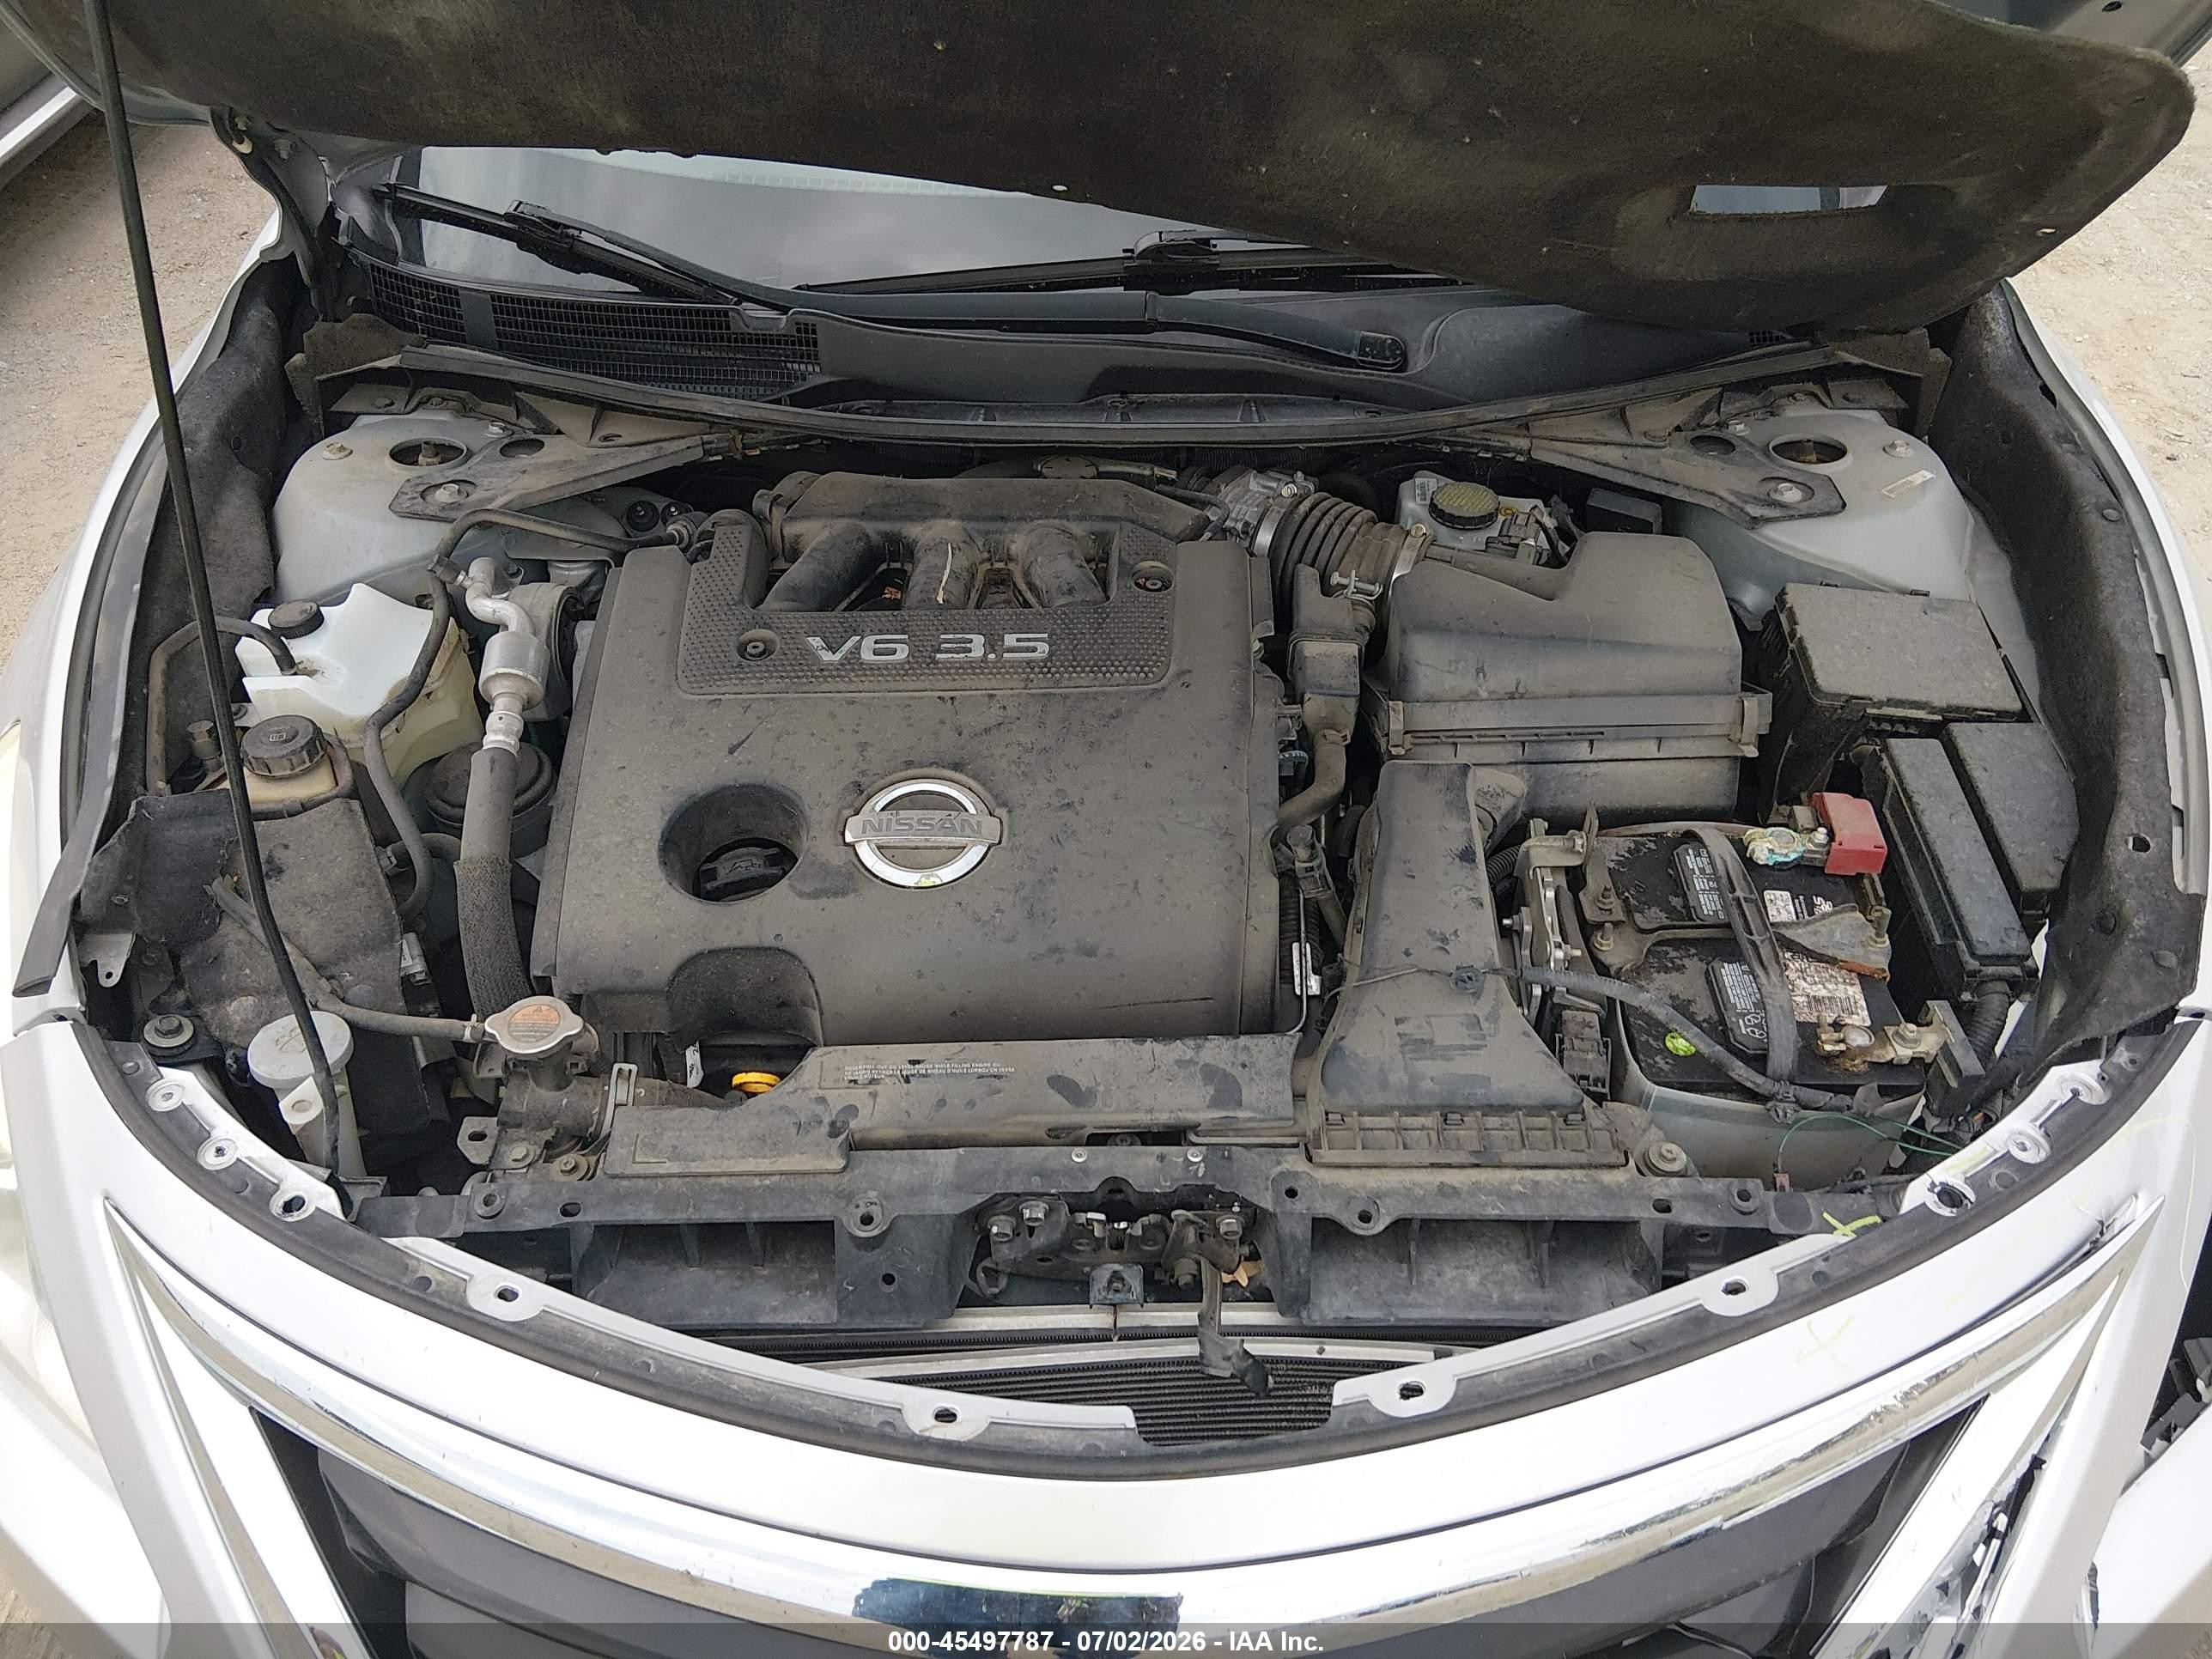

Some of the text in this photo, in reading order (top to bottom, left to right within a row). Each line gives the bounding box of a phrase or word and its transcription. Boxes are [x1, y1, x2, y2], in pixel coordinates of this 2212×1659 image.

[805, 633, 1049, 662] V6 3.5
[861, 816, 982, 836] NISSAN
